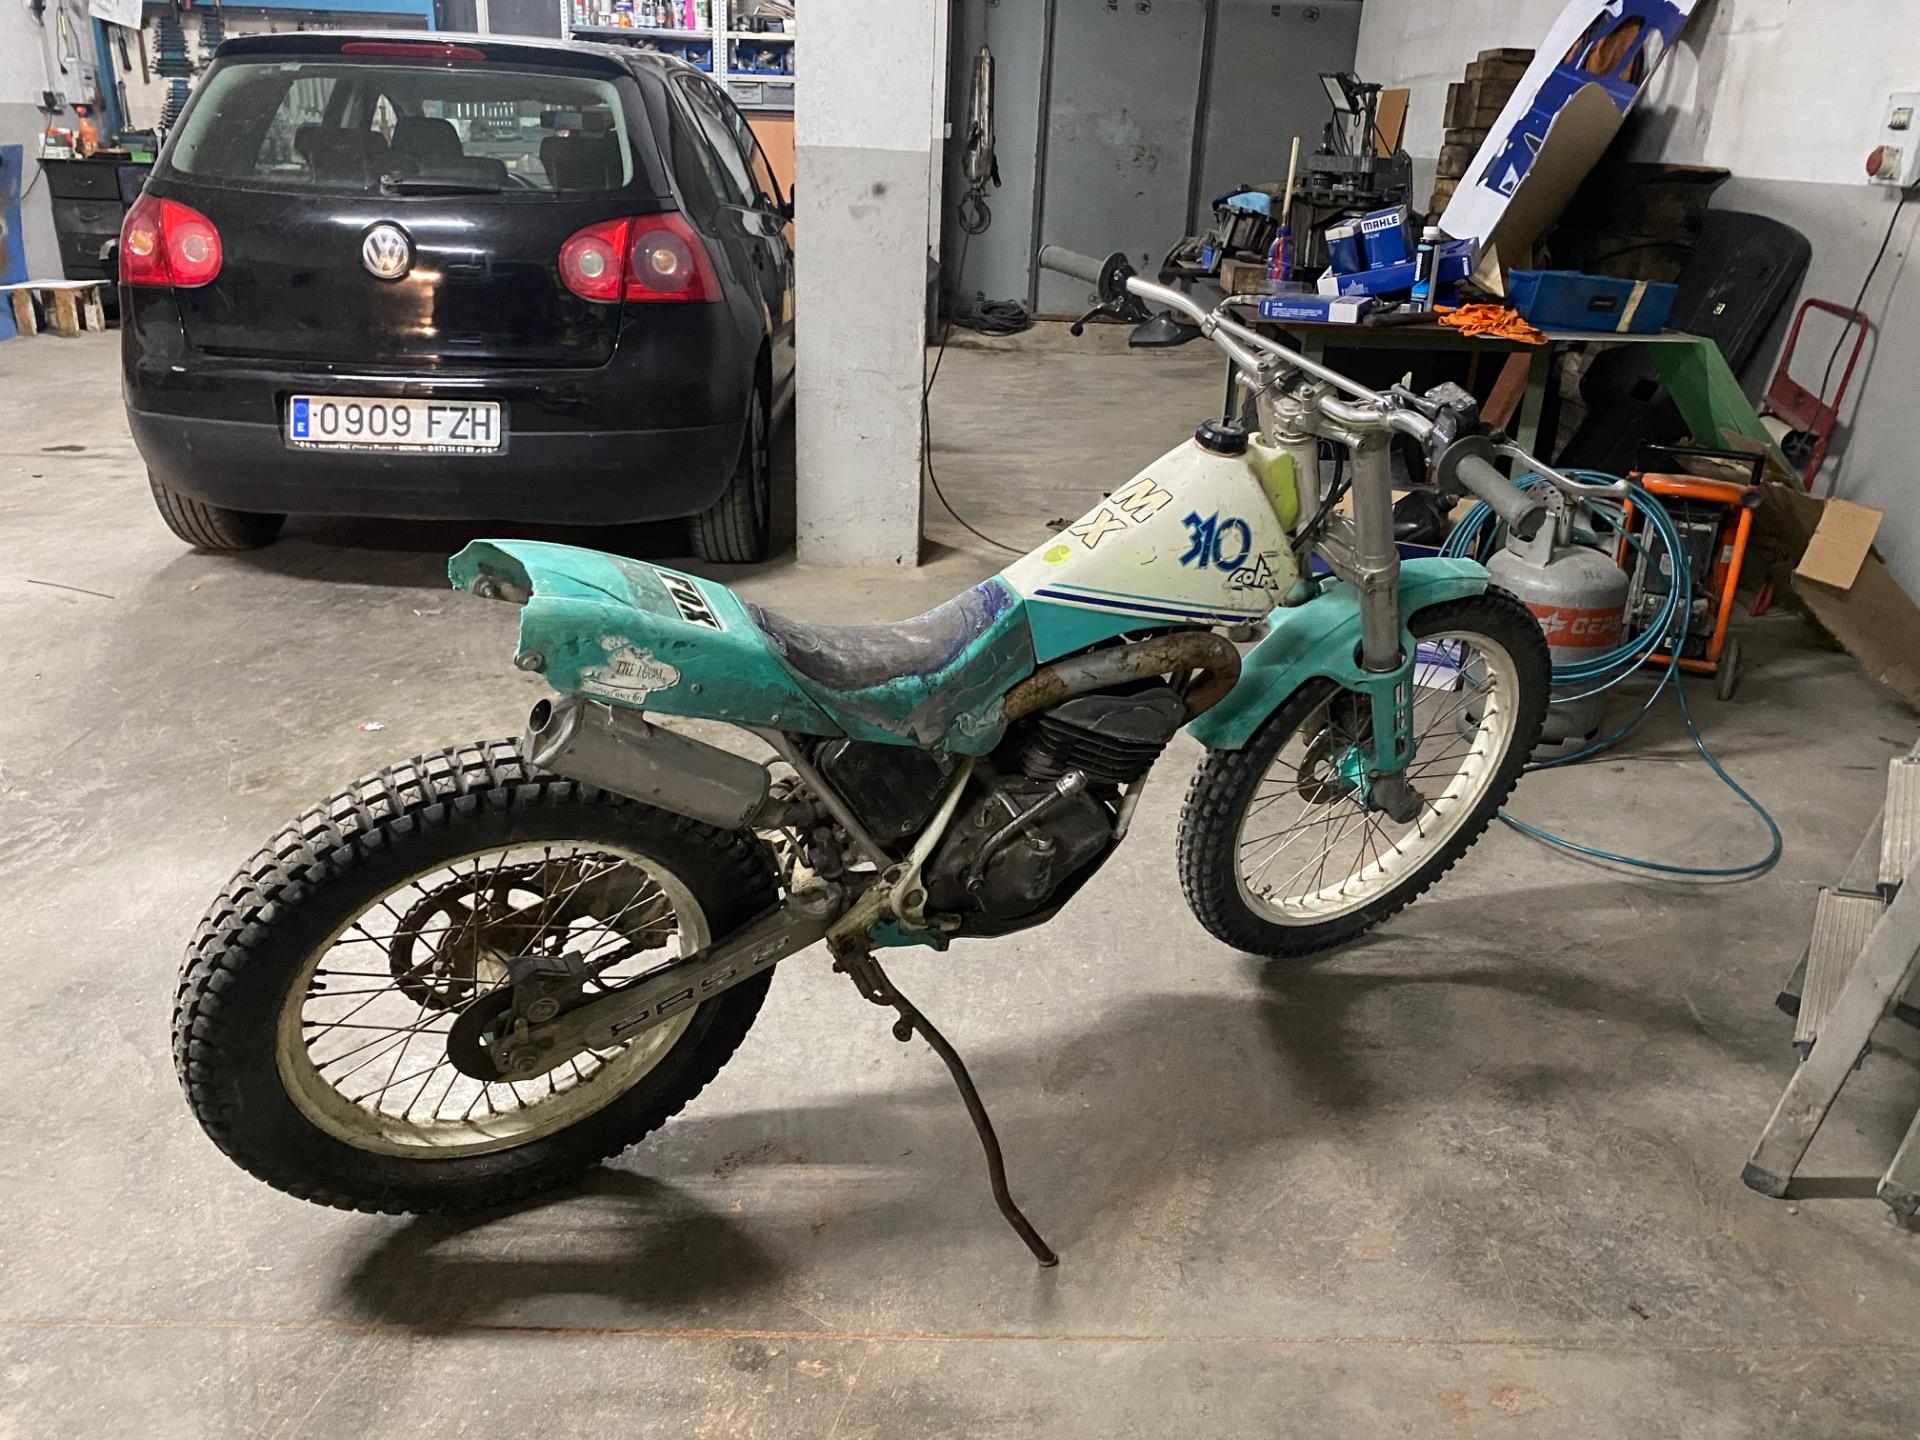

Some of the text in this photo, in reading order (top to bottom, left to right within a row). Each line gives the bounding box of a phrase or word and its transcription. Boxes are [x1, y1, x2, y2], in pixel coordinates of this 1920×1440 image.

[1363, 215, 1398, 231] MAHLE
[296, 422, 305, 433] E
[320, 402, 491, 440] 0909 FZH
[1178, 510, 1252, 572] 310
